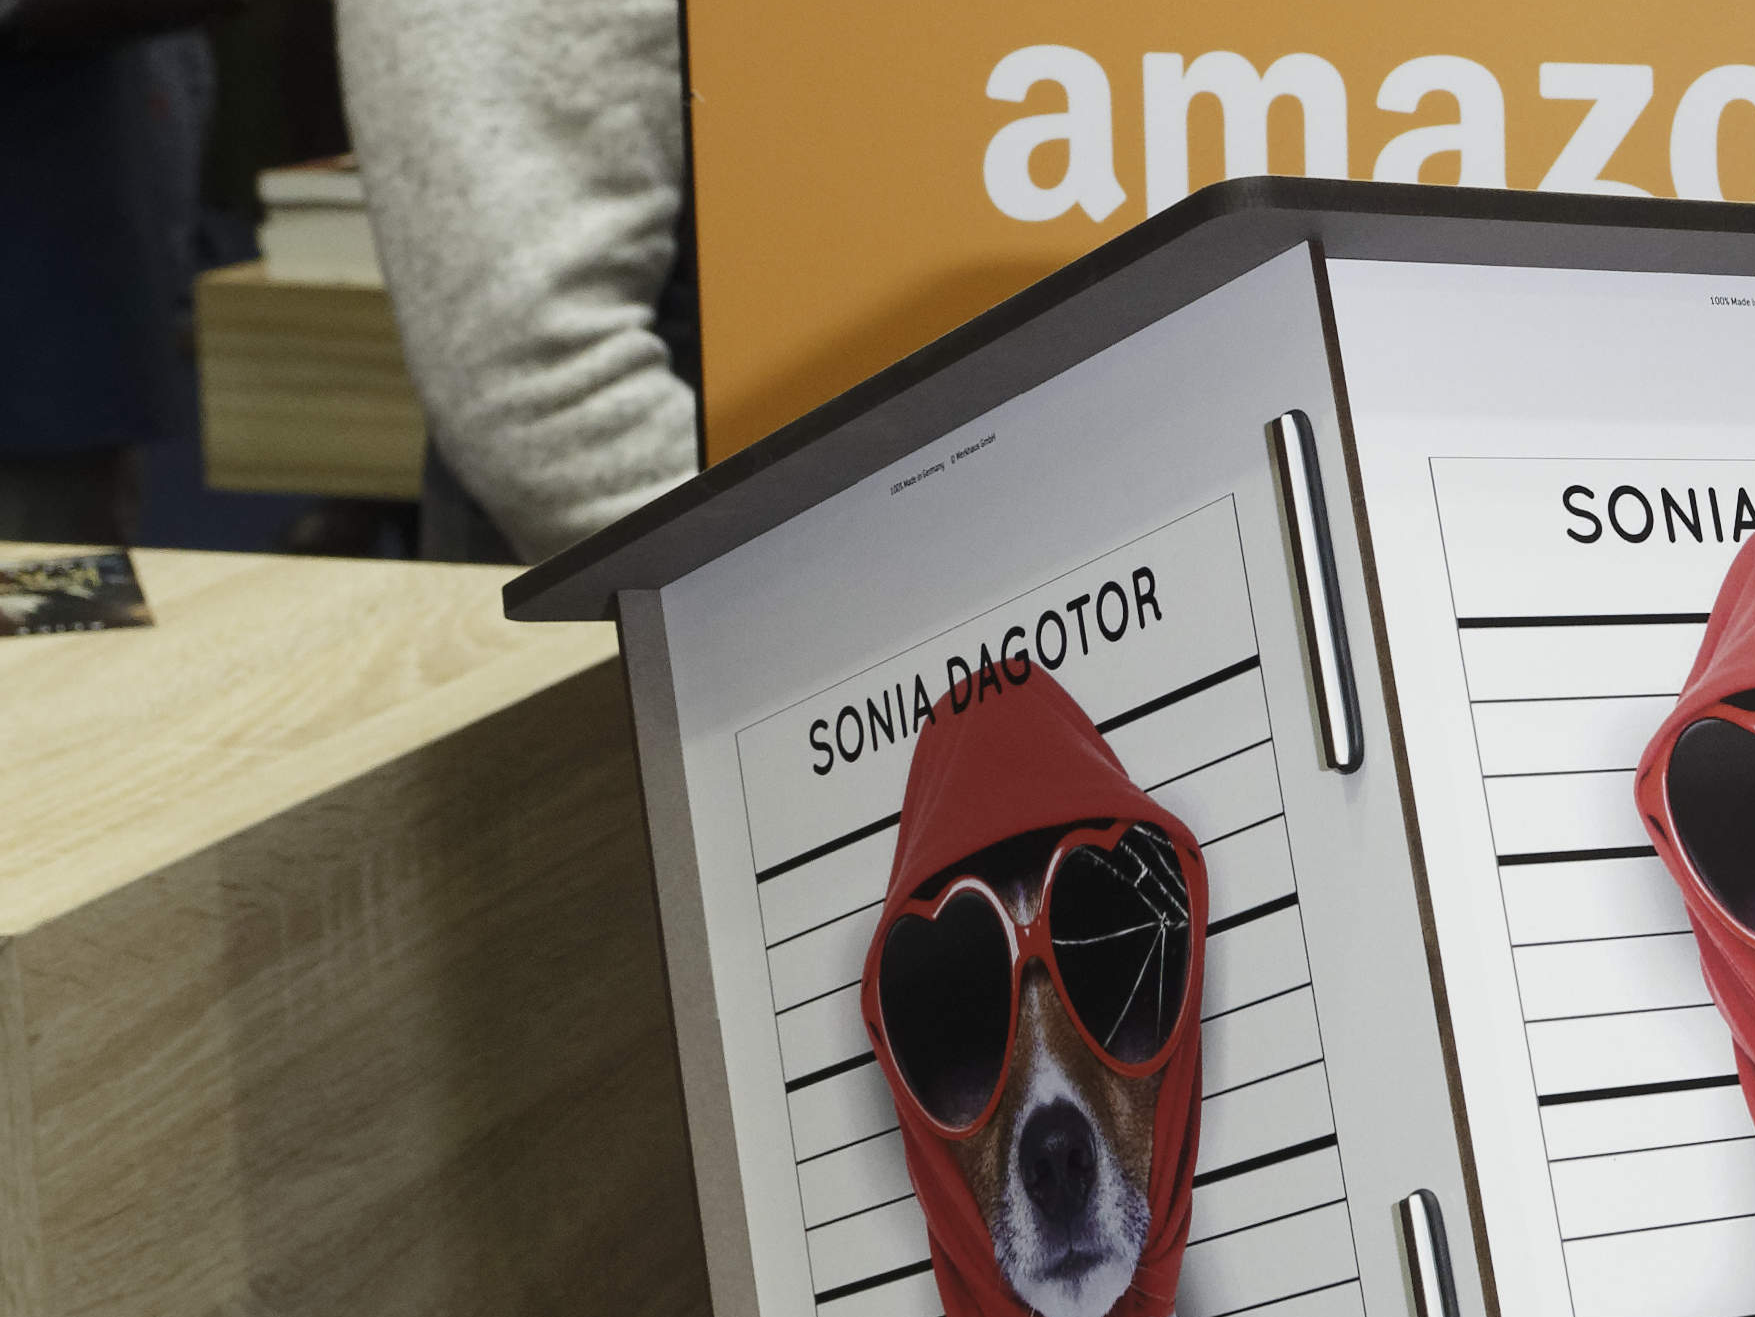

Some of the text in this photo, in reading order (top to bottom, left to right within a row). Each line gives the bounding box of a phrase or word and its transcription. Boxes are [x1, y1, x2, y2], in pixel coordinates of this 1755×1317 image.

[1731, 297, 1750, 306] Made
[809, 565, 1163, 776] SONIA DAGOTOR
